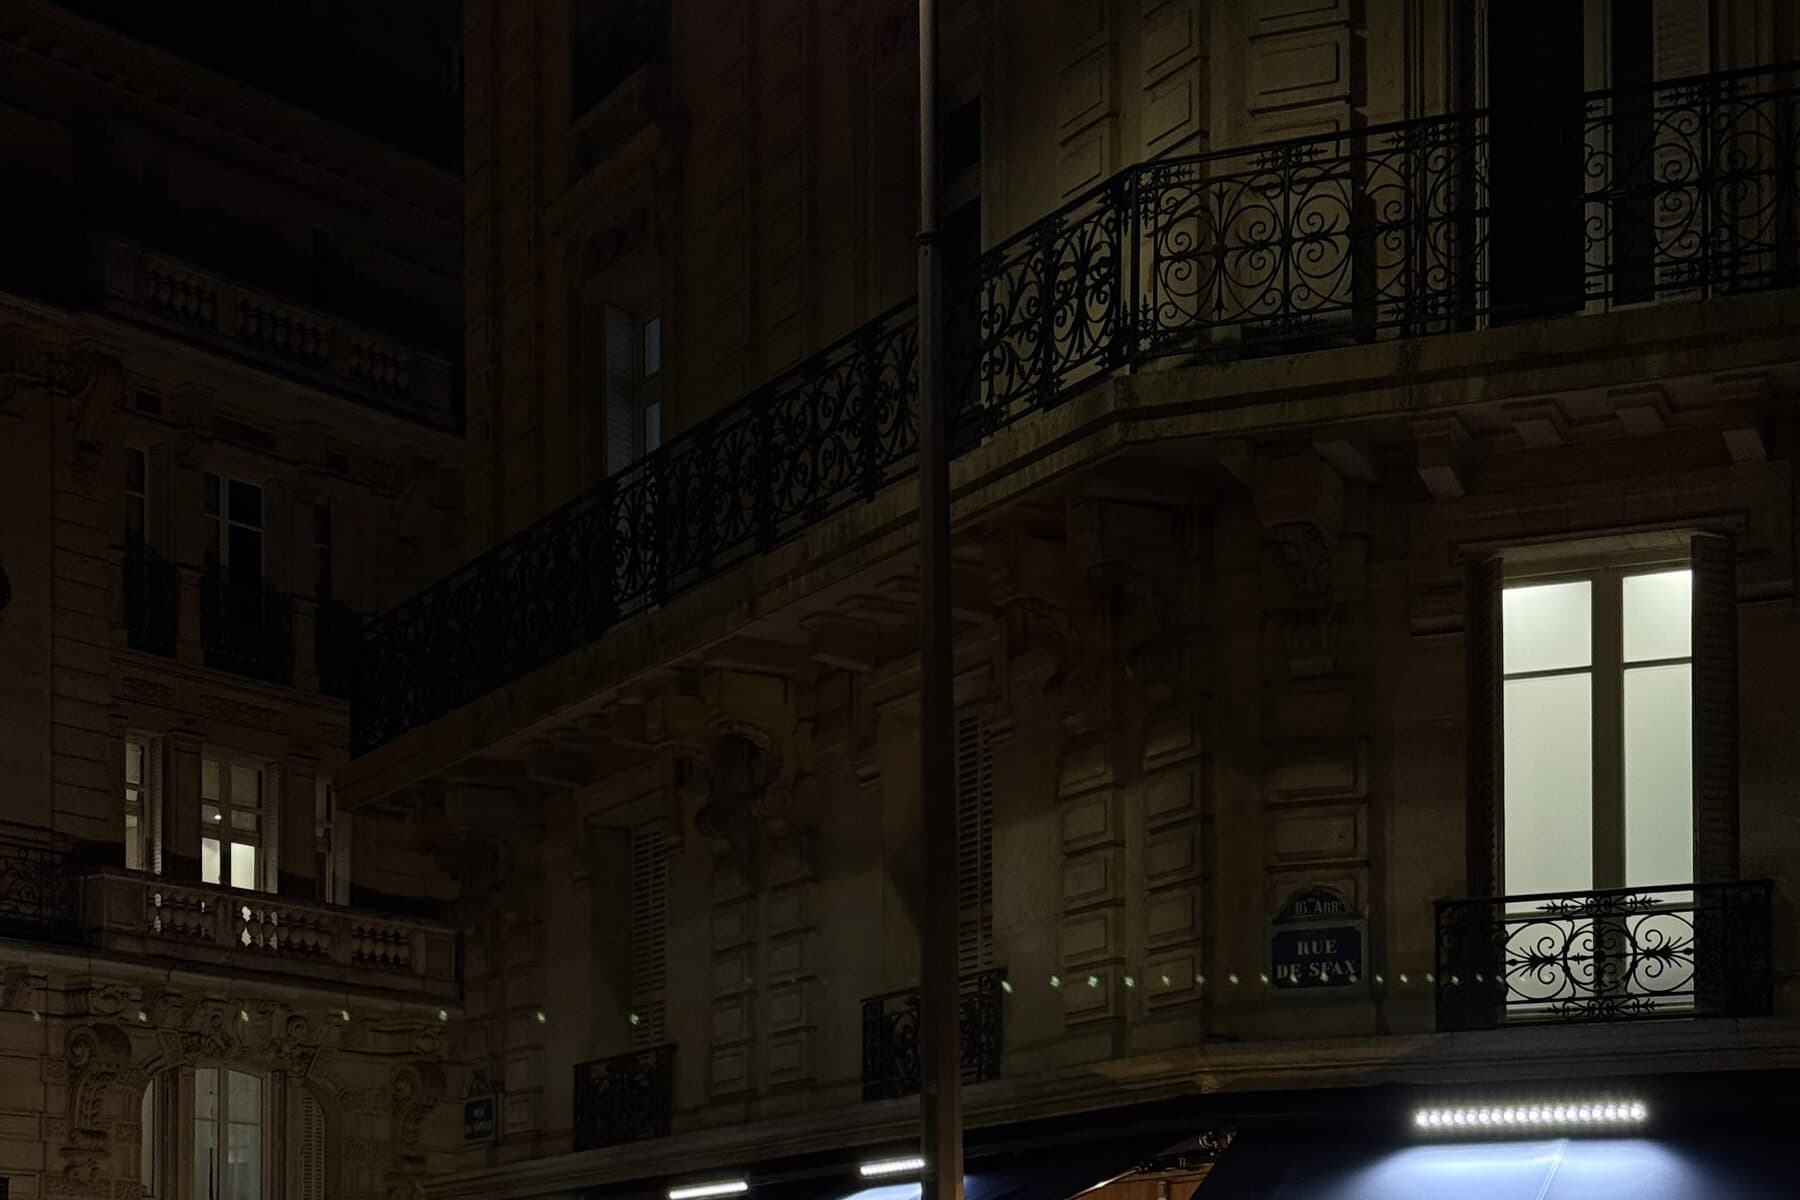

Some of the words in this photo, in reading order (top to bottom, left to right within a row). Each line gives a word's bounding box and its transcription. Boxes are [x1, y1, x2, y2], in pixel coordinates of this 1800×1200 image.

[1297, 939, 1337, 956] RUE
[1276, 963, 1302, 979] DE
[1309, 960, 1356, 977] SFAX
